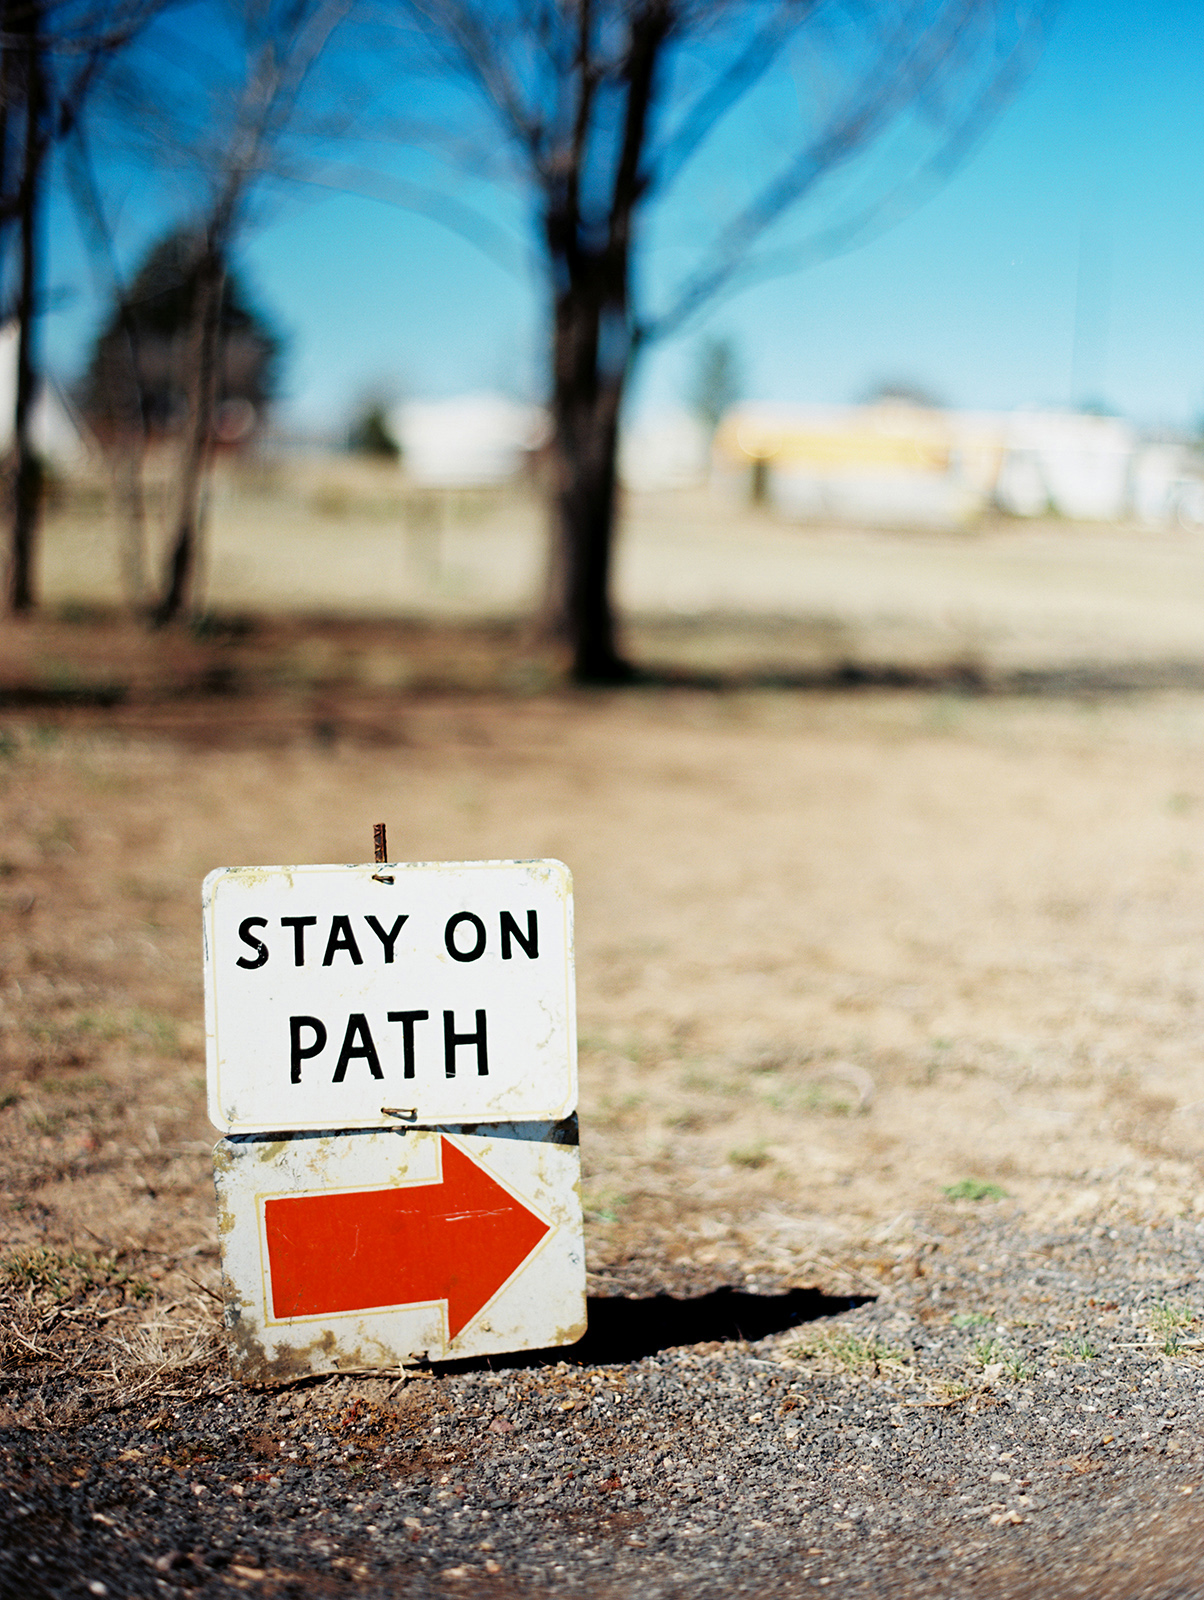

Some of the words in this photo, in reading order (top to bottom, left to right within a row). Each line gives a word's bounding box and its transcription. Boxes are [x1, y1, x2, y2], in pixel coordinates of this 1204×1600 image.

[235, 914, 410, 970] STAY
[444, 909, 540, 963] ON
[289, 1009, 490, 1085] PATH
